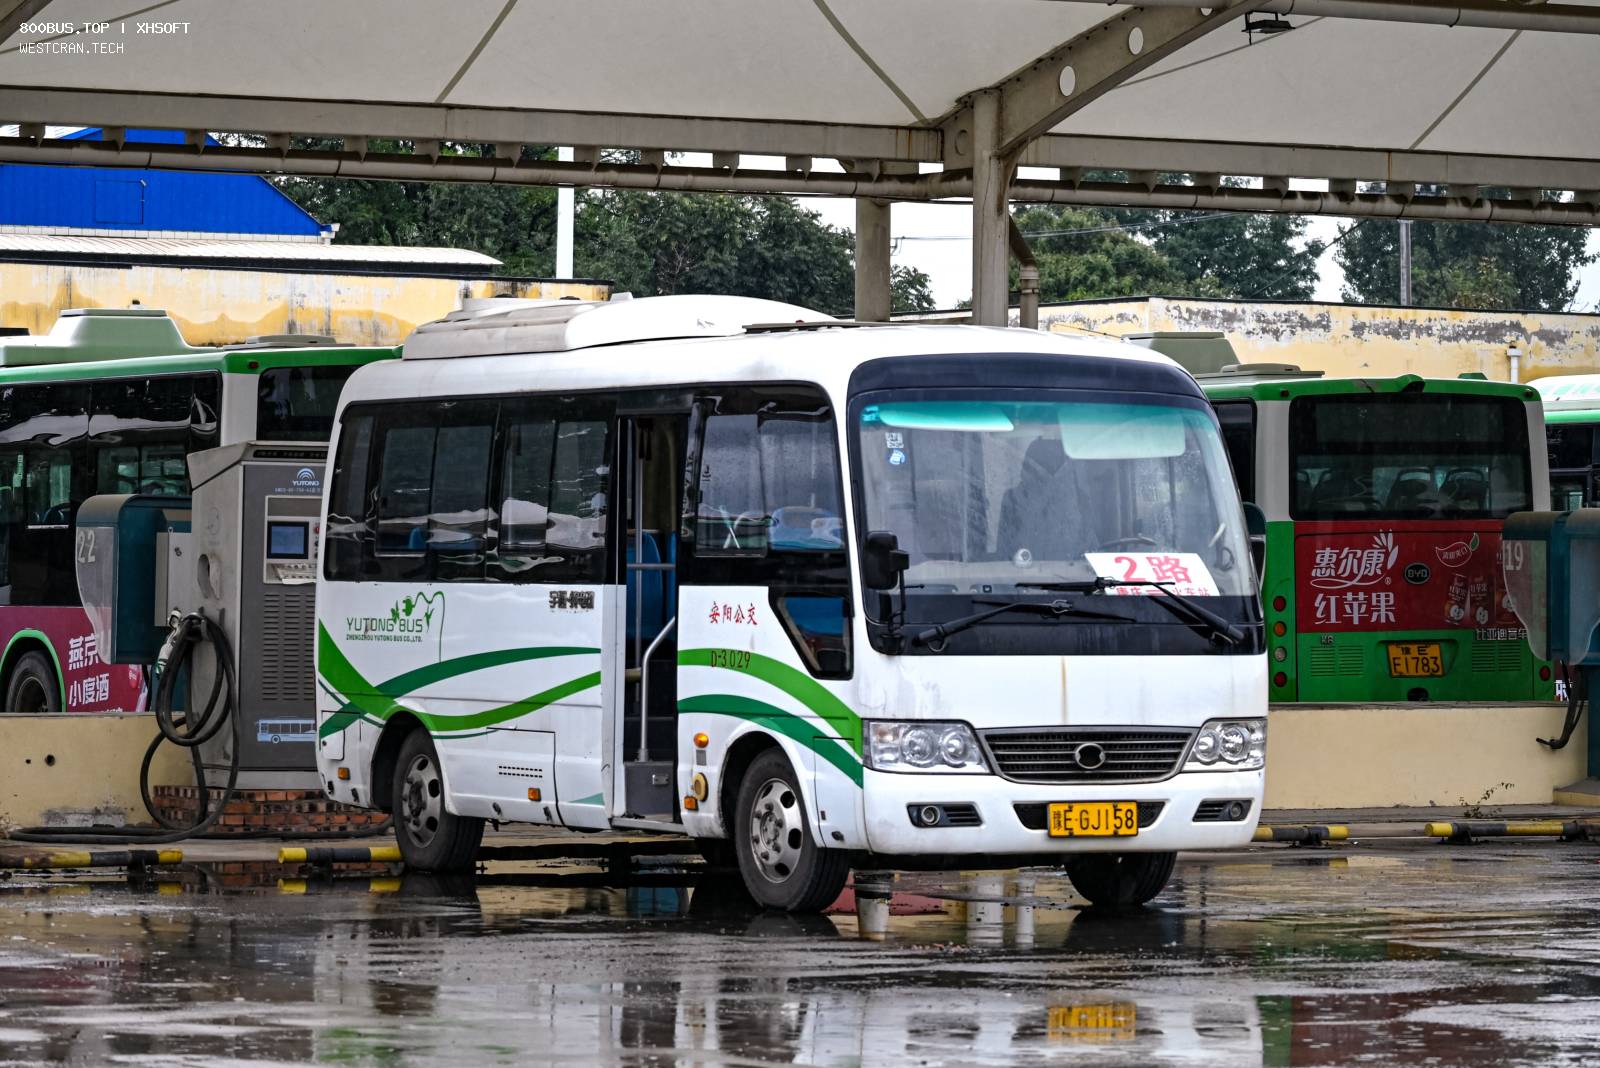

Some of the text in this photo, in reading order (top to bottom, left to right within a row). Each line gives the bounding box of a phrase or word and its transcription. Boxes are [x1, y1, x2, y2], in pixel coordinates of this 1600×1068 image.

[78, 530, 95, 563] 22
[1505, 541, 1524, 571] 19
[1311, 547, 1386, 577] 惠尔康
[1407, 569, 1428, 578] BYD
[709, 601, 758, 625] 安阳公交
[1315, 592, 1396, 625] 红苹果
[346, 617, 423, 632] YUTONG BUS
[374, 634, 392, 642] YUTONG
[711, 649, 751, 669] D-3029
[1392, 656, 1440, 674] E1783
[68, 673, 110, 707] 小度酒
